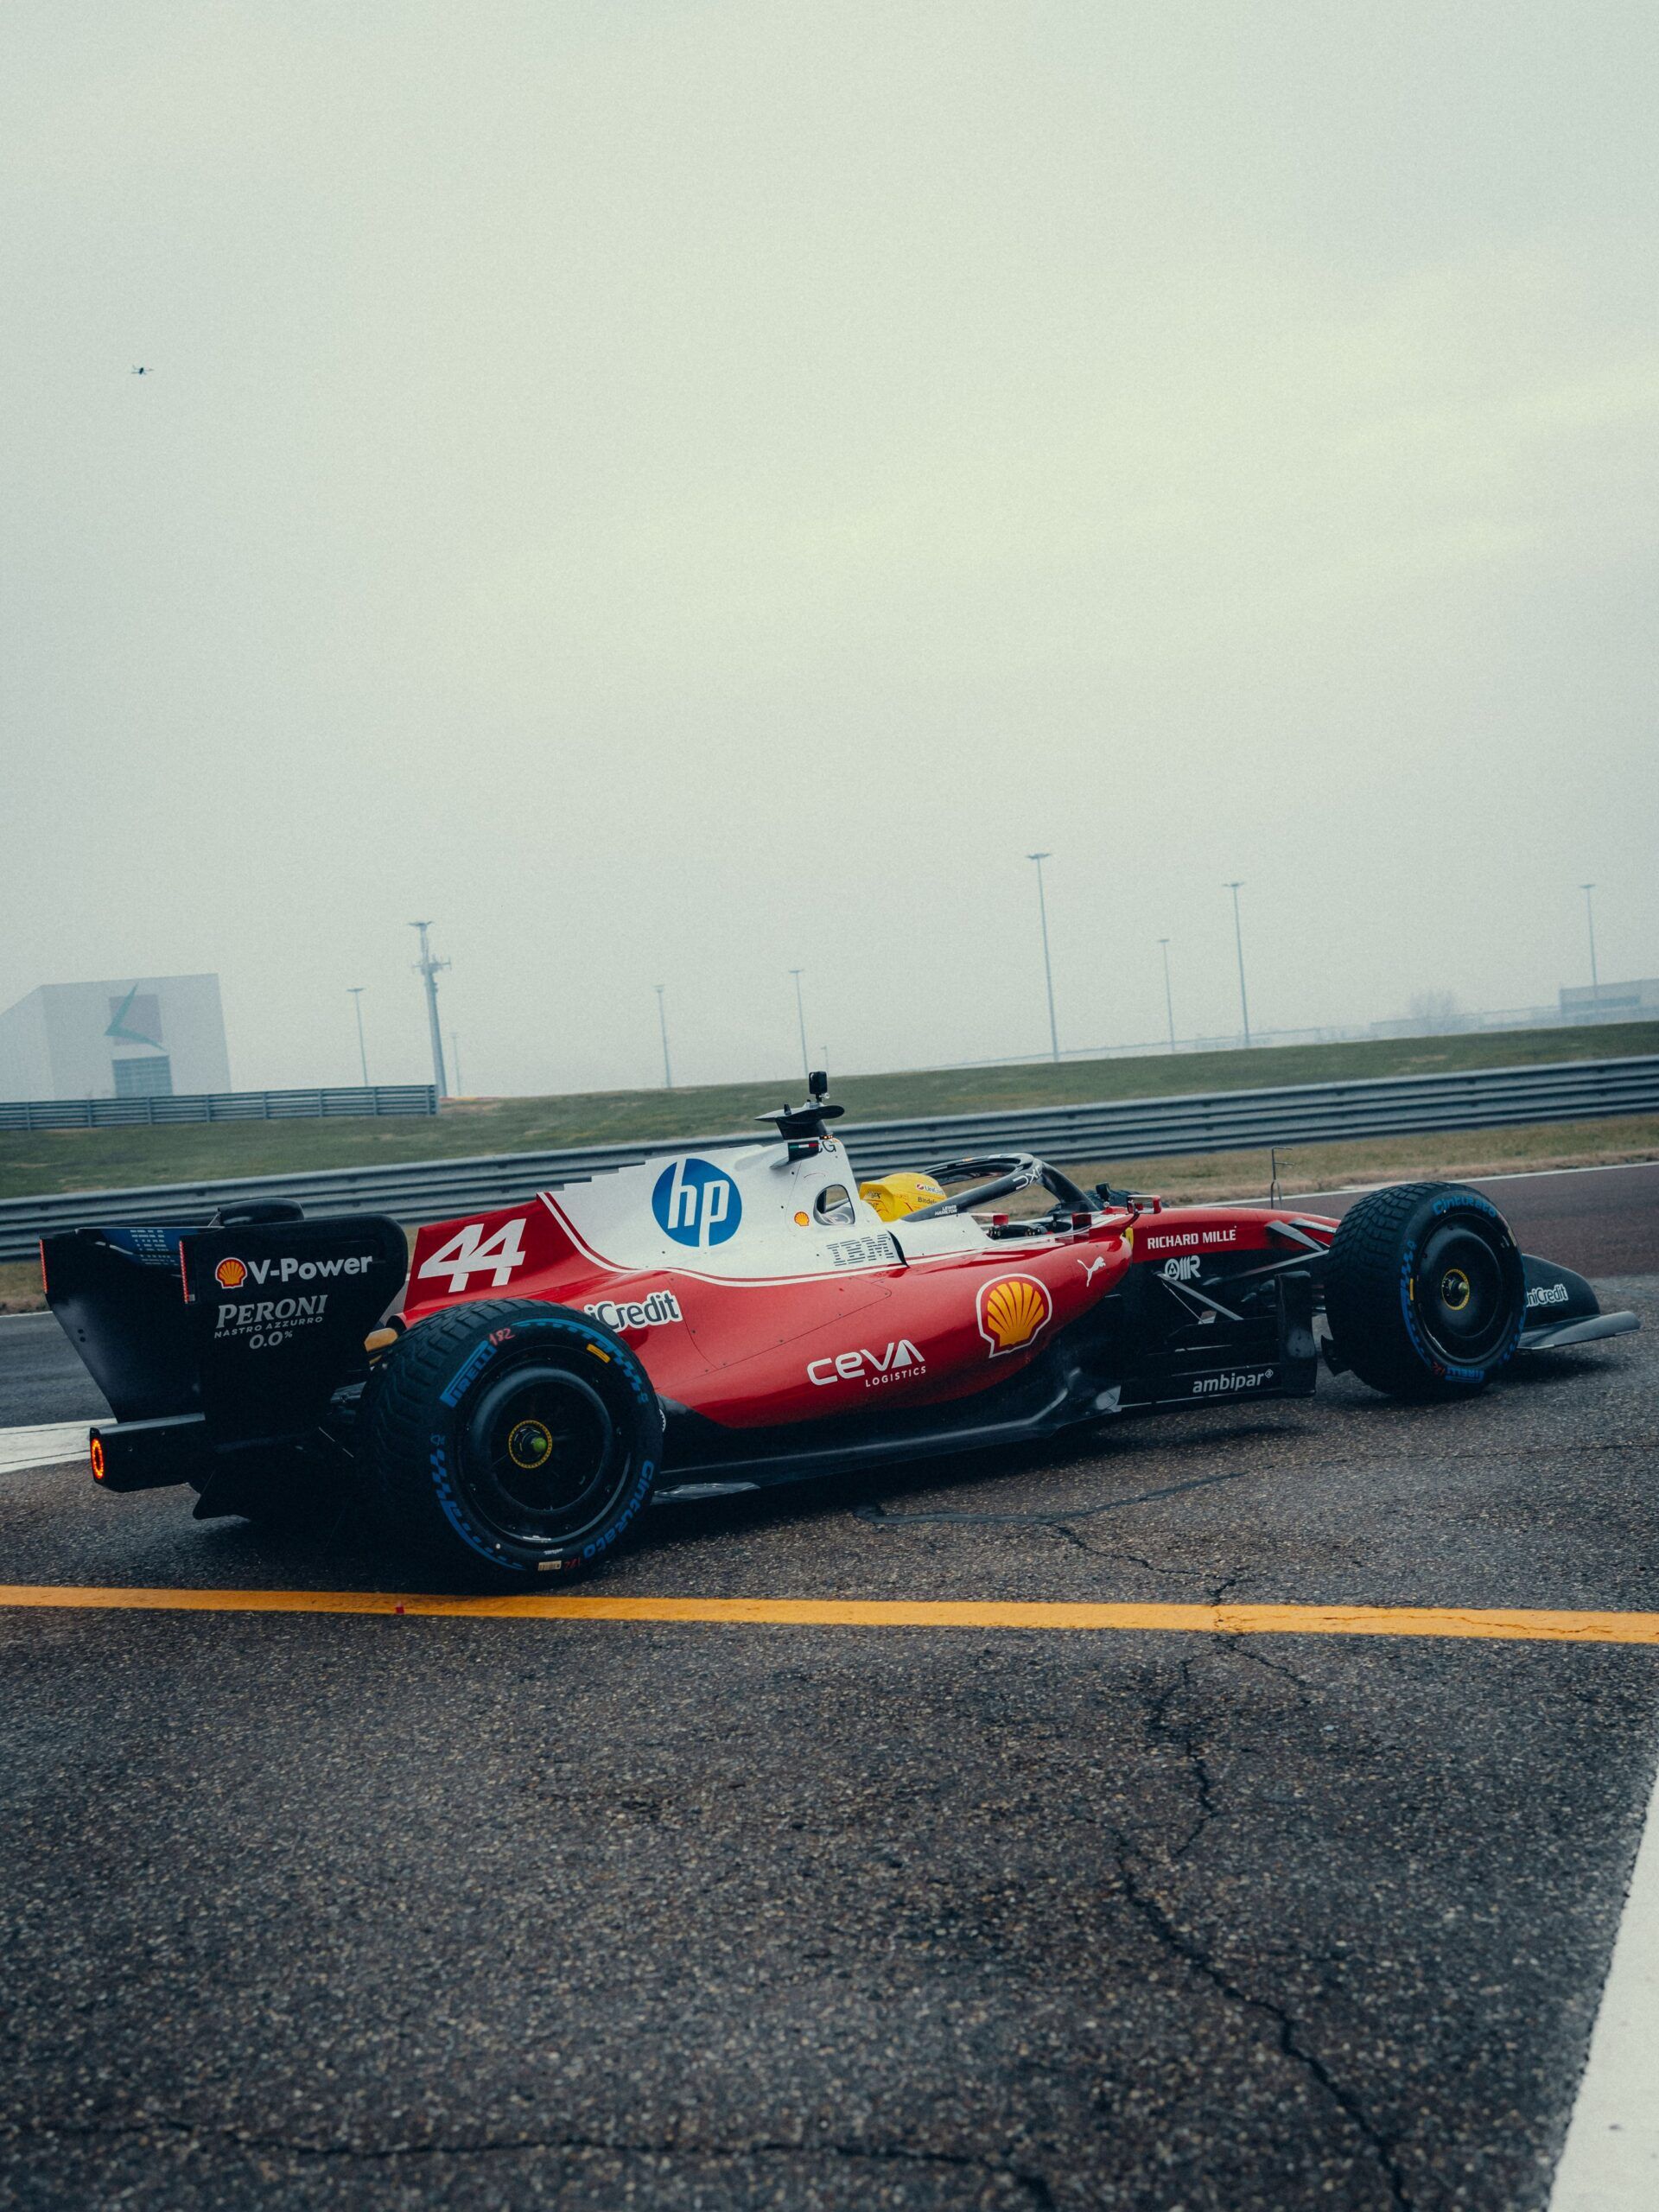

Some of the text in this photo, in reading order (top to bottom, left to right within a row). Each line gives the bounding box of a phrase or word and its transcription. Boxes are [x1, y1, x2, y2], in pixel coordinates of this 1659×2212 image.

[667, 1158, 730, 1247] hp
[826, 1234, 894, 1267] IBM
[1147, 1230, 1236, 1249] RICHARD MILLE
[417, 1218, 526, 1293] 44
[247, 1255, 373, 1284] V-Power
[216, 1294, 328, 1329] PERONI
[214, 1316, 323, 1338] NASTRO AZZURRO
[488, 1327, 517, 1346] 182
[249, 1330, 293, 1350] 0.0%
[439, 1339, 498, 1408] PIRELLI
[866, 1366, 926, 1387] LOGISTICS
[1192, 1372, 1264, 1393] ambipar
